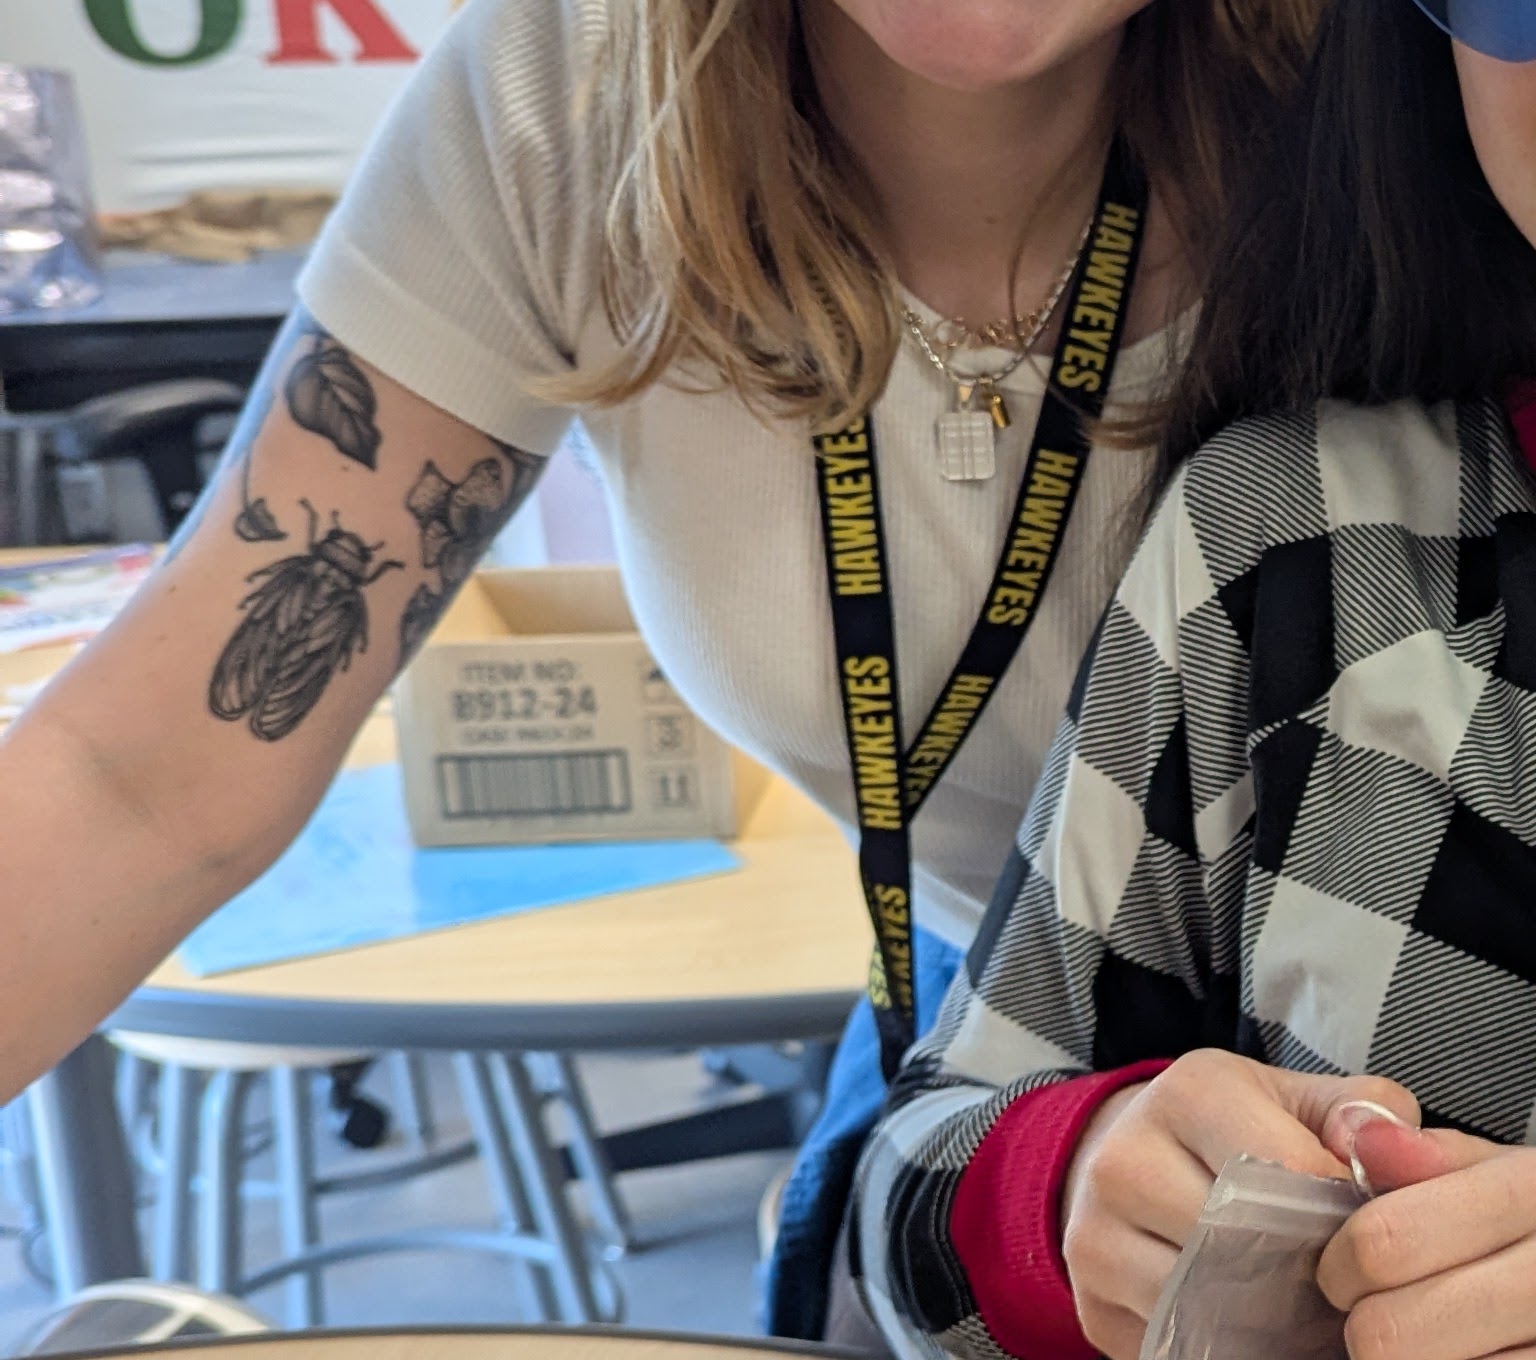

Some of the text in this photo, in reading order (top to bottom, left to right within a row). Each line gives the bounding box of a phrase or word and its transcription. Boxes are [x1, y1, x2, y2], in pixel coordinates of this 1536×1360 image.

[1057, 201, 1140, 392] HAWKEYES
[987, 447, 1078, 627] HAWKEYES
[844, 654, 901, 831] HAWKEYES
